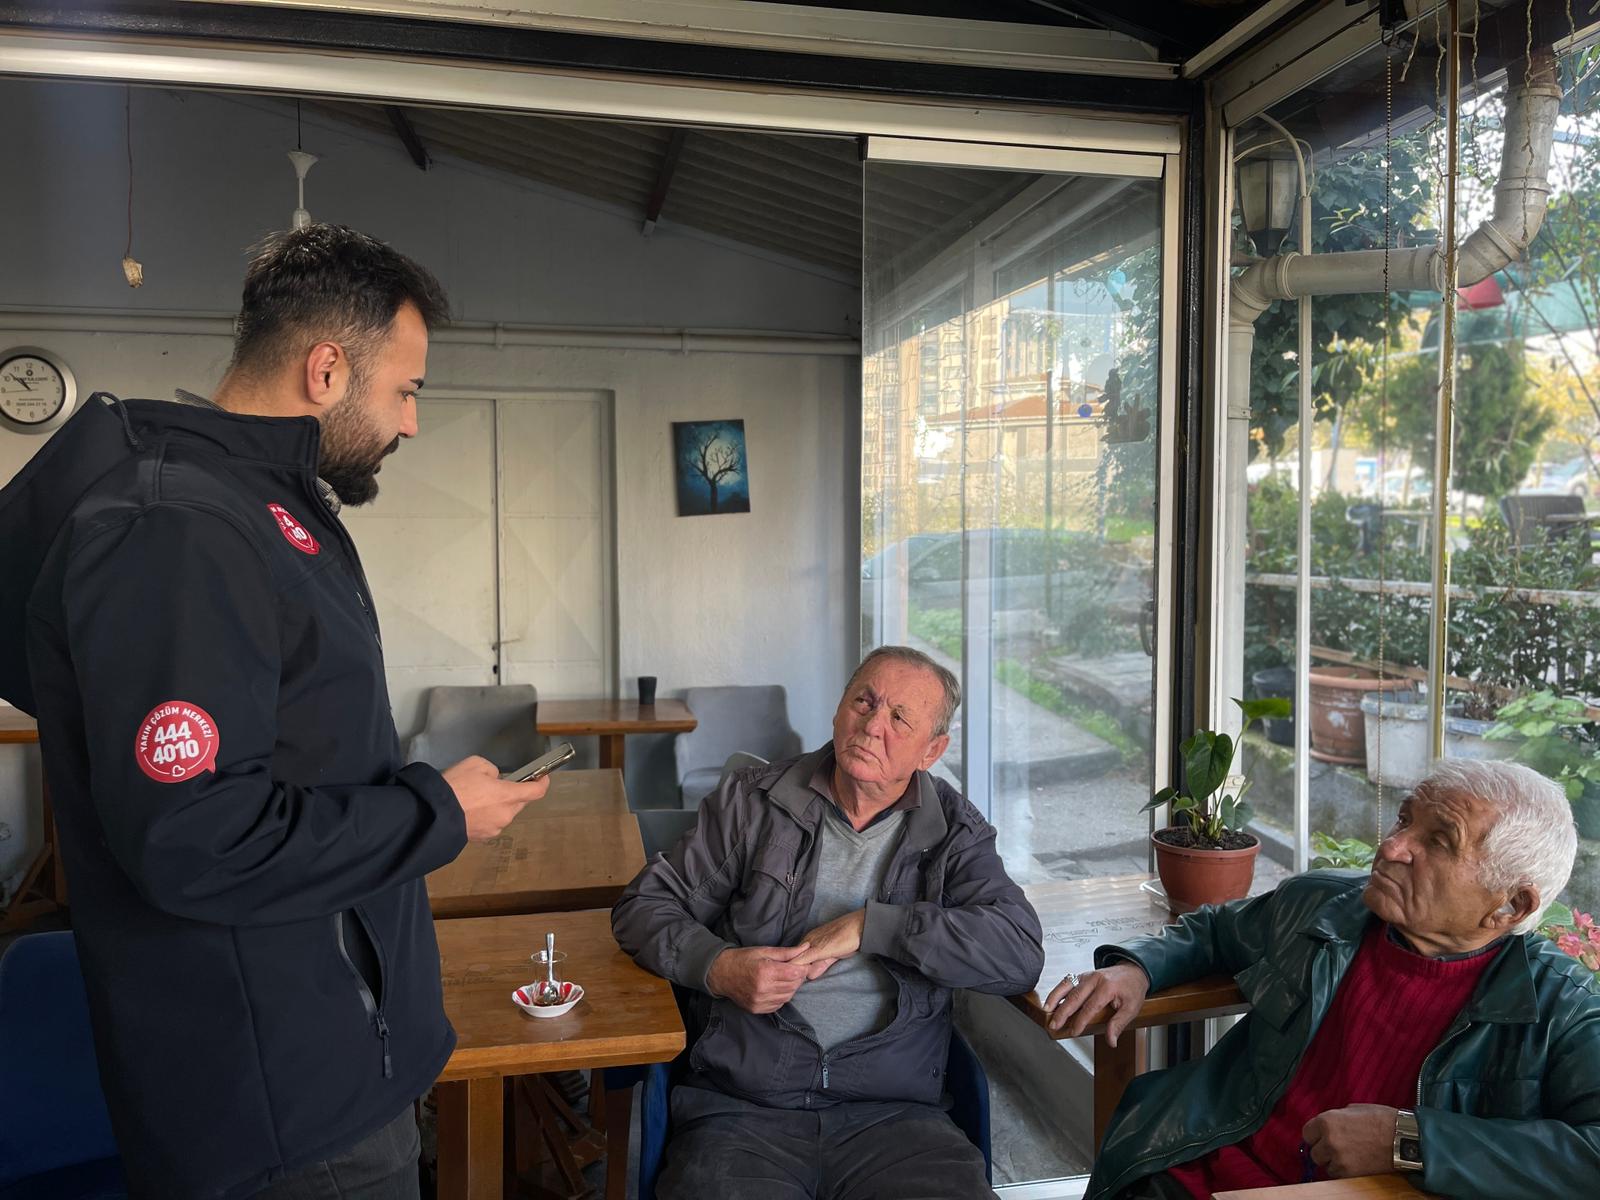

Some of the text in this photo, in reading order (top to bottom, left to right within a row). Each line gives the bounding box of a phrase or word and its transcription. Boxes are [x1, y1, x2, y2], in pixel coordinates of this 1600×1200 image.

[141, 706, 214, 752] YAKIN ÇÖZÜM MERKEZİ
[154, 721, 192, 744] 444
[153, 739, 199, 764] 4010
